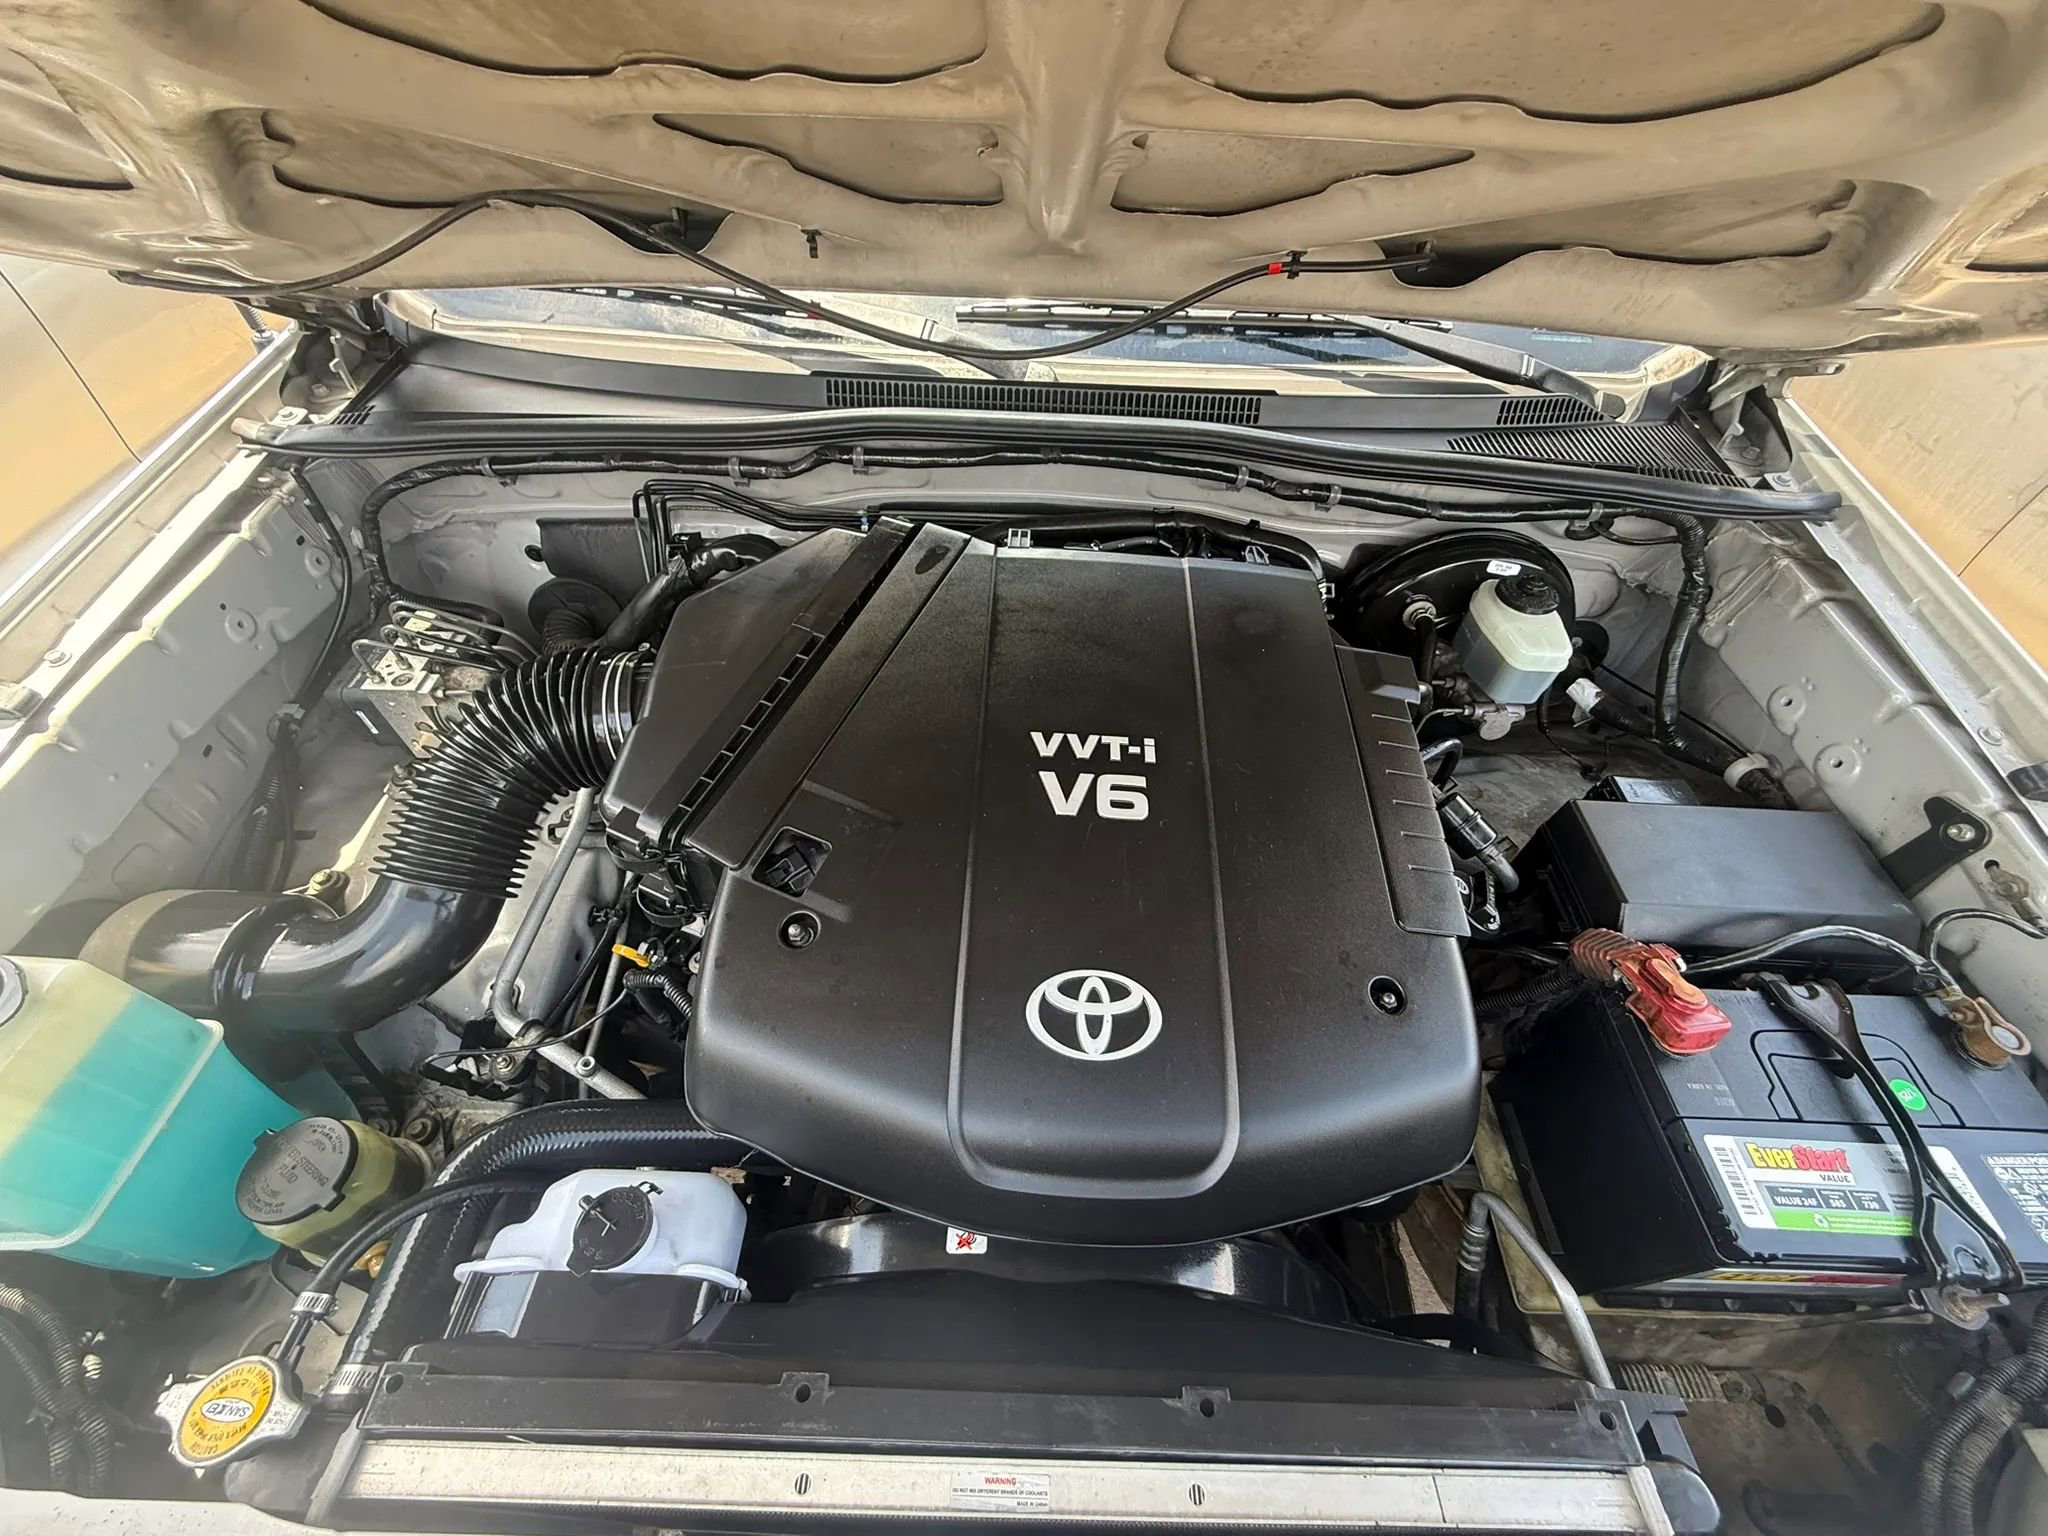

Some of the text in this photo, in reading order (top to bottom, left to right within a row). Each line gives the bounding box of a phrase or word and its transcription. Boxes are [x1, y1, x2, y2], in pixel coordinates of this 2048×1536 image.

[1030, 731, 1157, 764] VVT-i
[1038, 771, 1149, 820] V6
[1744, 1142, 1851, 1172] EverStart
[1819, 1174, 1851, 1183] VALUE
[206, 1403, 250, 1417] SANKEI
[984, 1476, 1017, 1485] WARNING
